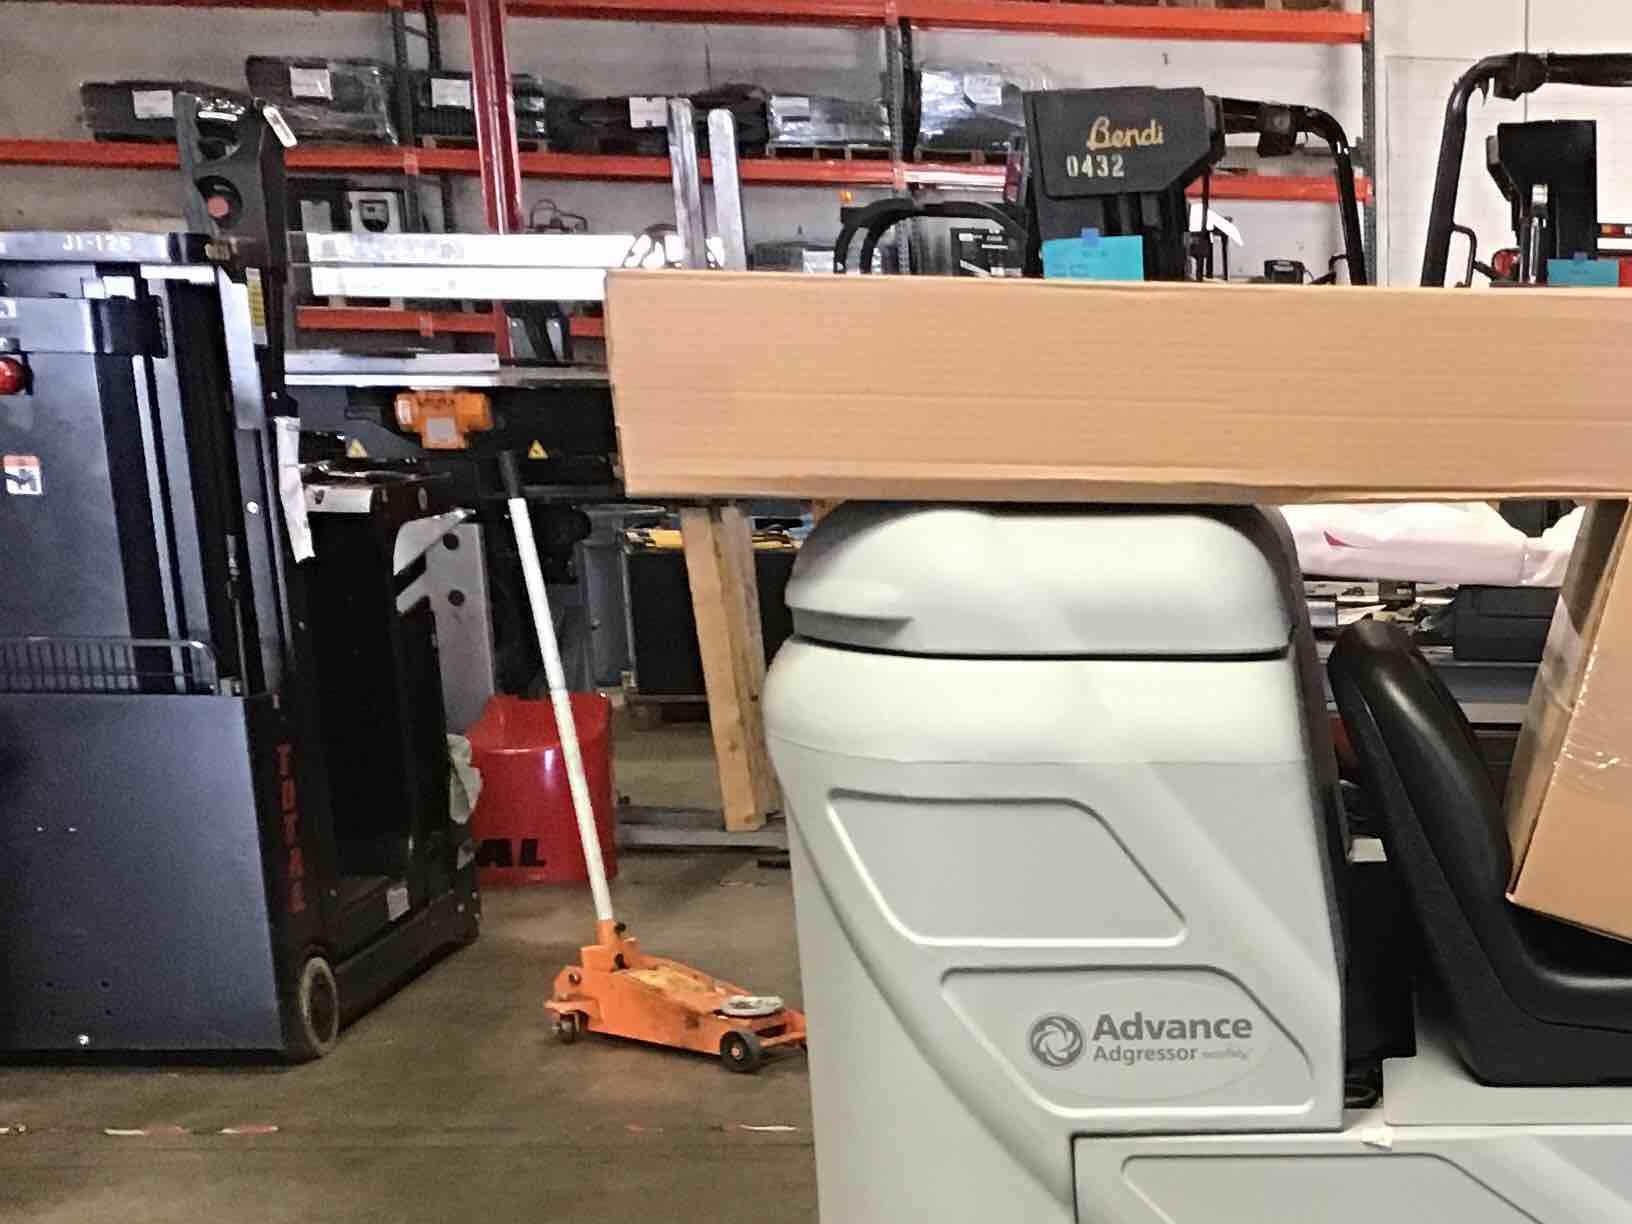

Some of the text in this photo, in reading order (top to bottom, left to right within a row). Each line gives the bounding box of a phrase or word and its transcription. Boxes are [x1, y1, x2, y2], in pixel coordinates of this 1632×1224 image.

[1086, 115, 1164, 150] Bendi
[1066, 154, 1125, 178] 0432
[1091, 1011, 1253, 1041] Advance
[1093, 1045, 1198, 1065] Adgressor
